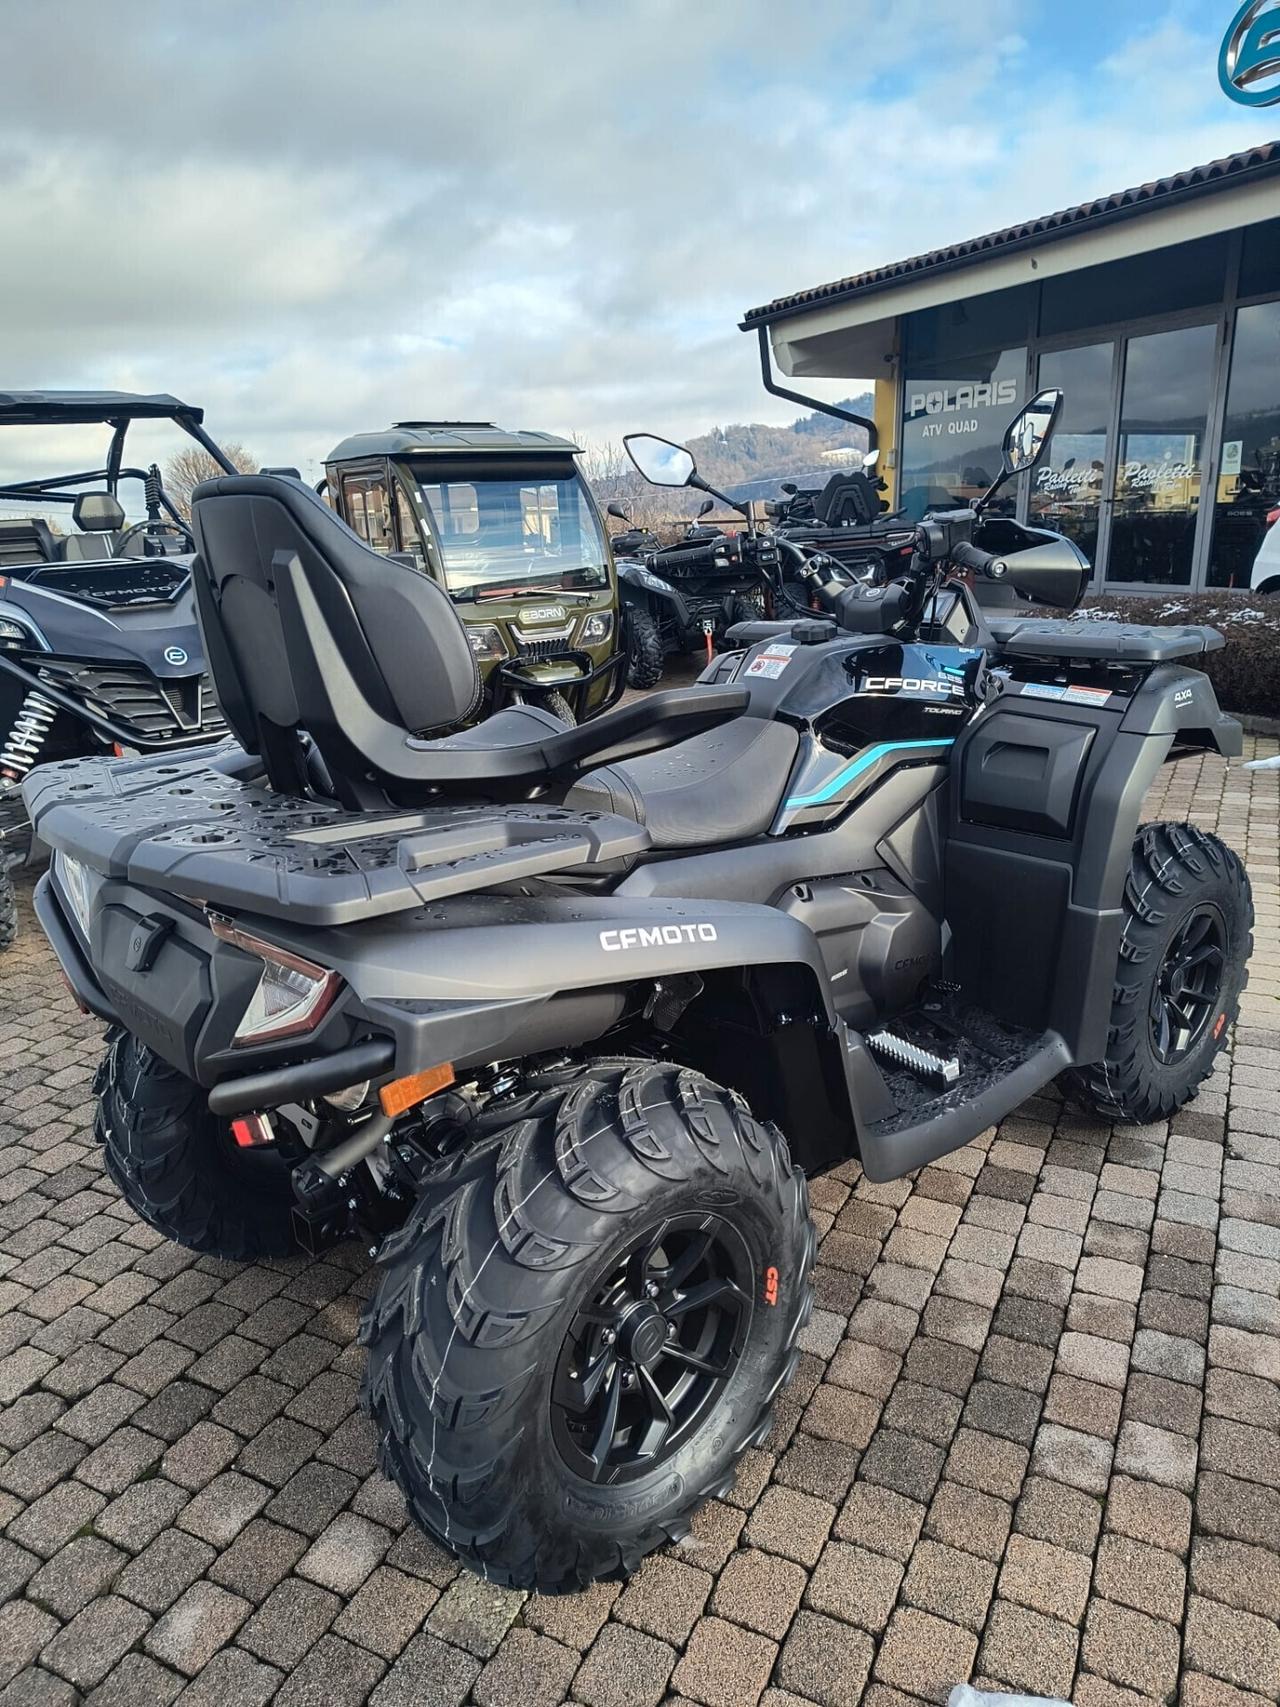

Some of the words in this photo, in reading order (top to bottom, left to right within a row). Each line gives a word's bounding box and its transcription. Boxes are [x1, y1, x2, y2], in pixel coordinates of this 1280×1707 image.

[910, 379, 1017, 417] POLARIS
[922, 423, 943, 438] ATV
[948, 419, 978, 435] QUAD
[1036, 466, 1097, 486] Paoletti
[1123, 461, 1195, 482] Paoletti
[92, 585, 172, 598] CFMOTO
[522, 606, 562, 620] EBORN
[864, 676, 966, 697] CFORCE
[599, 922, 718, 952] CFMOTO
[766, 1266, 779, 1307] CST
